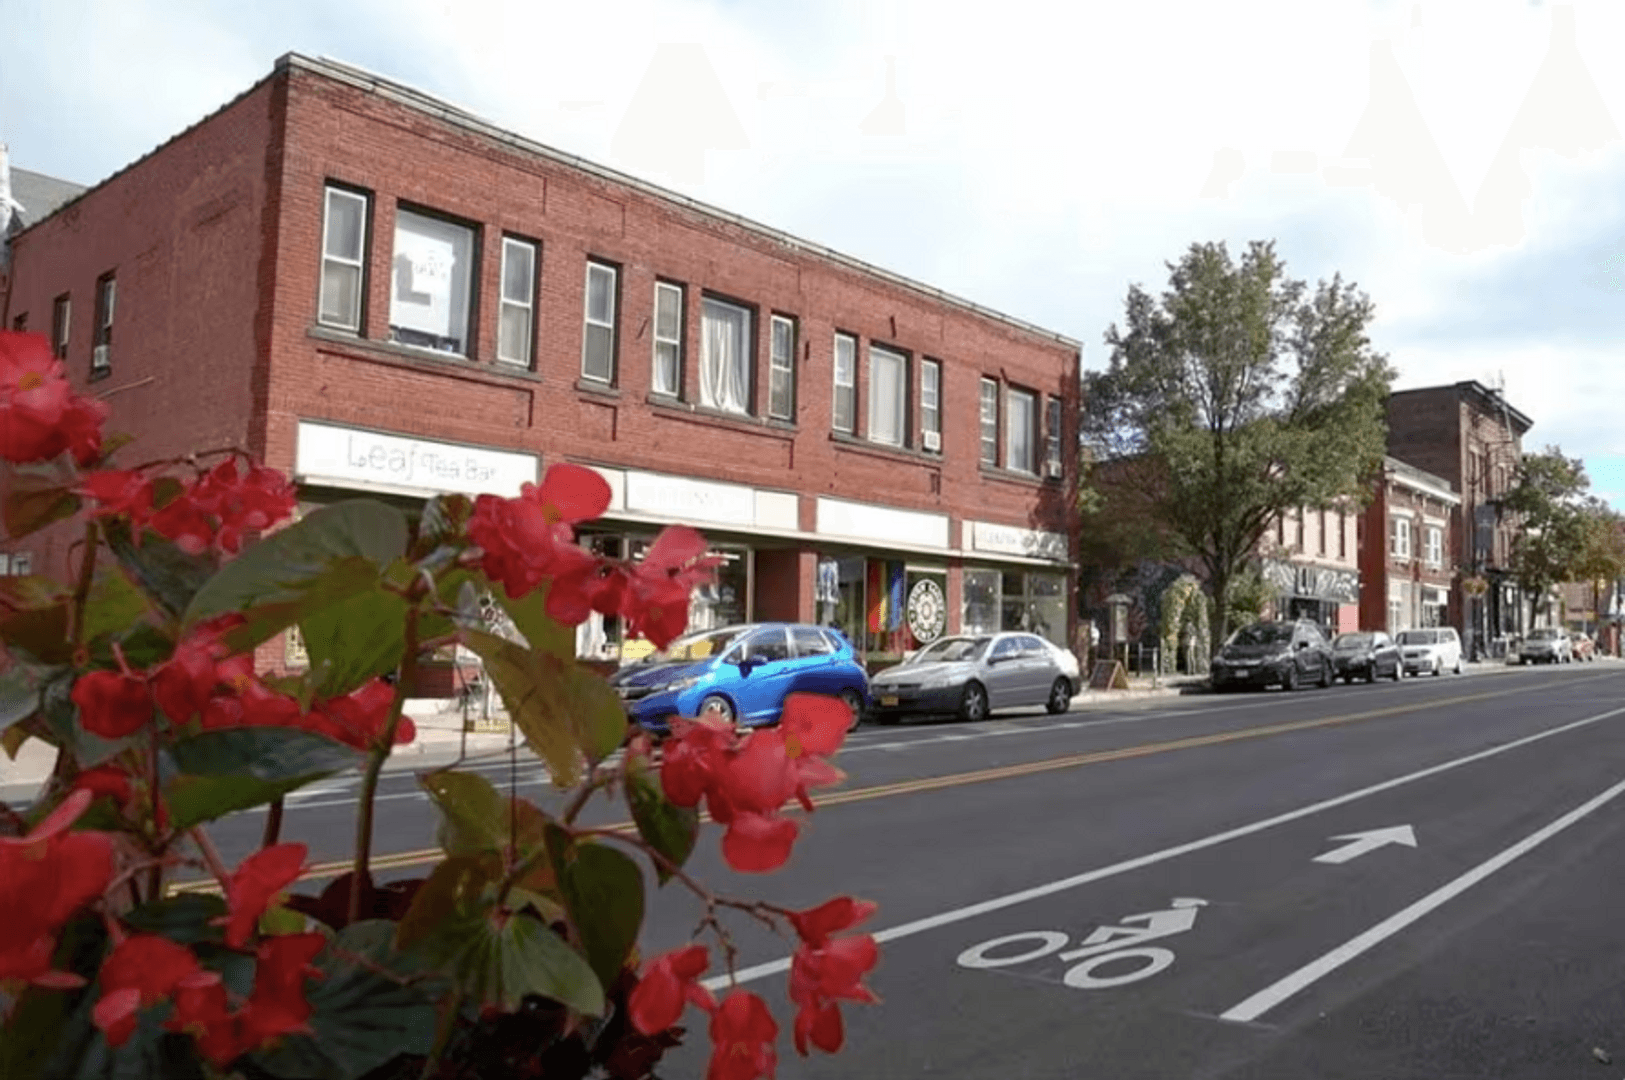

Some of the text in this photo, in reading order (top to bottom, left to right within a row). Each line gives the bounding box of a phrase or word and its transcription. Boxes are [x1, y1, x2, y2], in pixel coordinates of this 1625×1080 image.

[346, 433, 497, 481] Leaf Tea Bar
